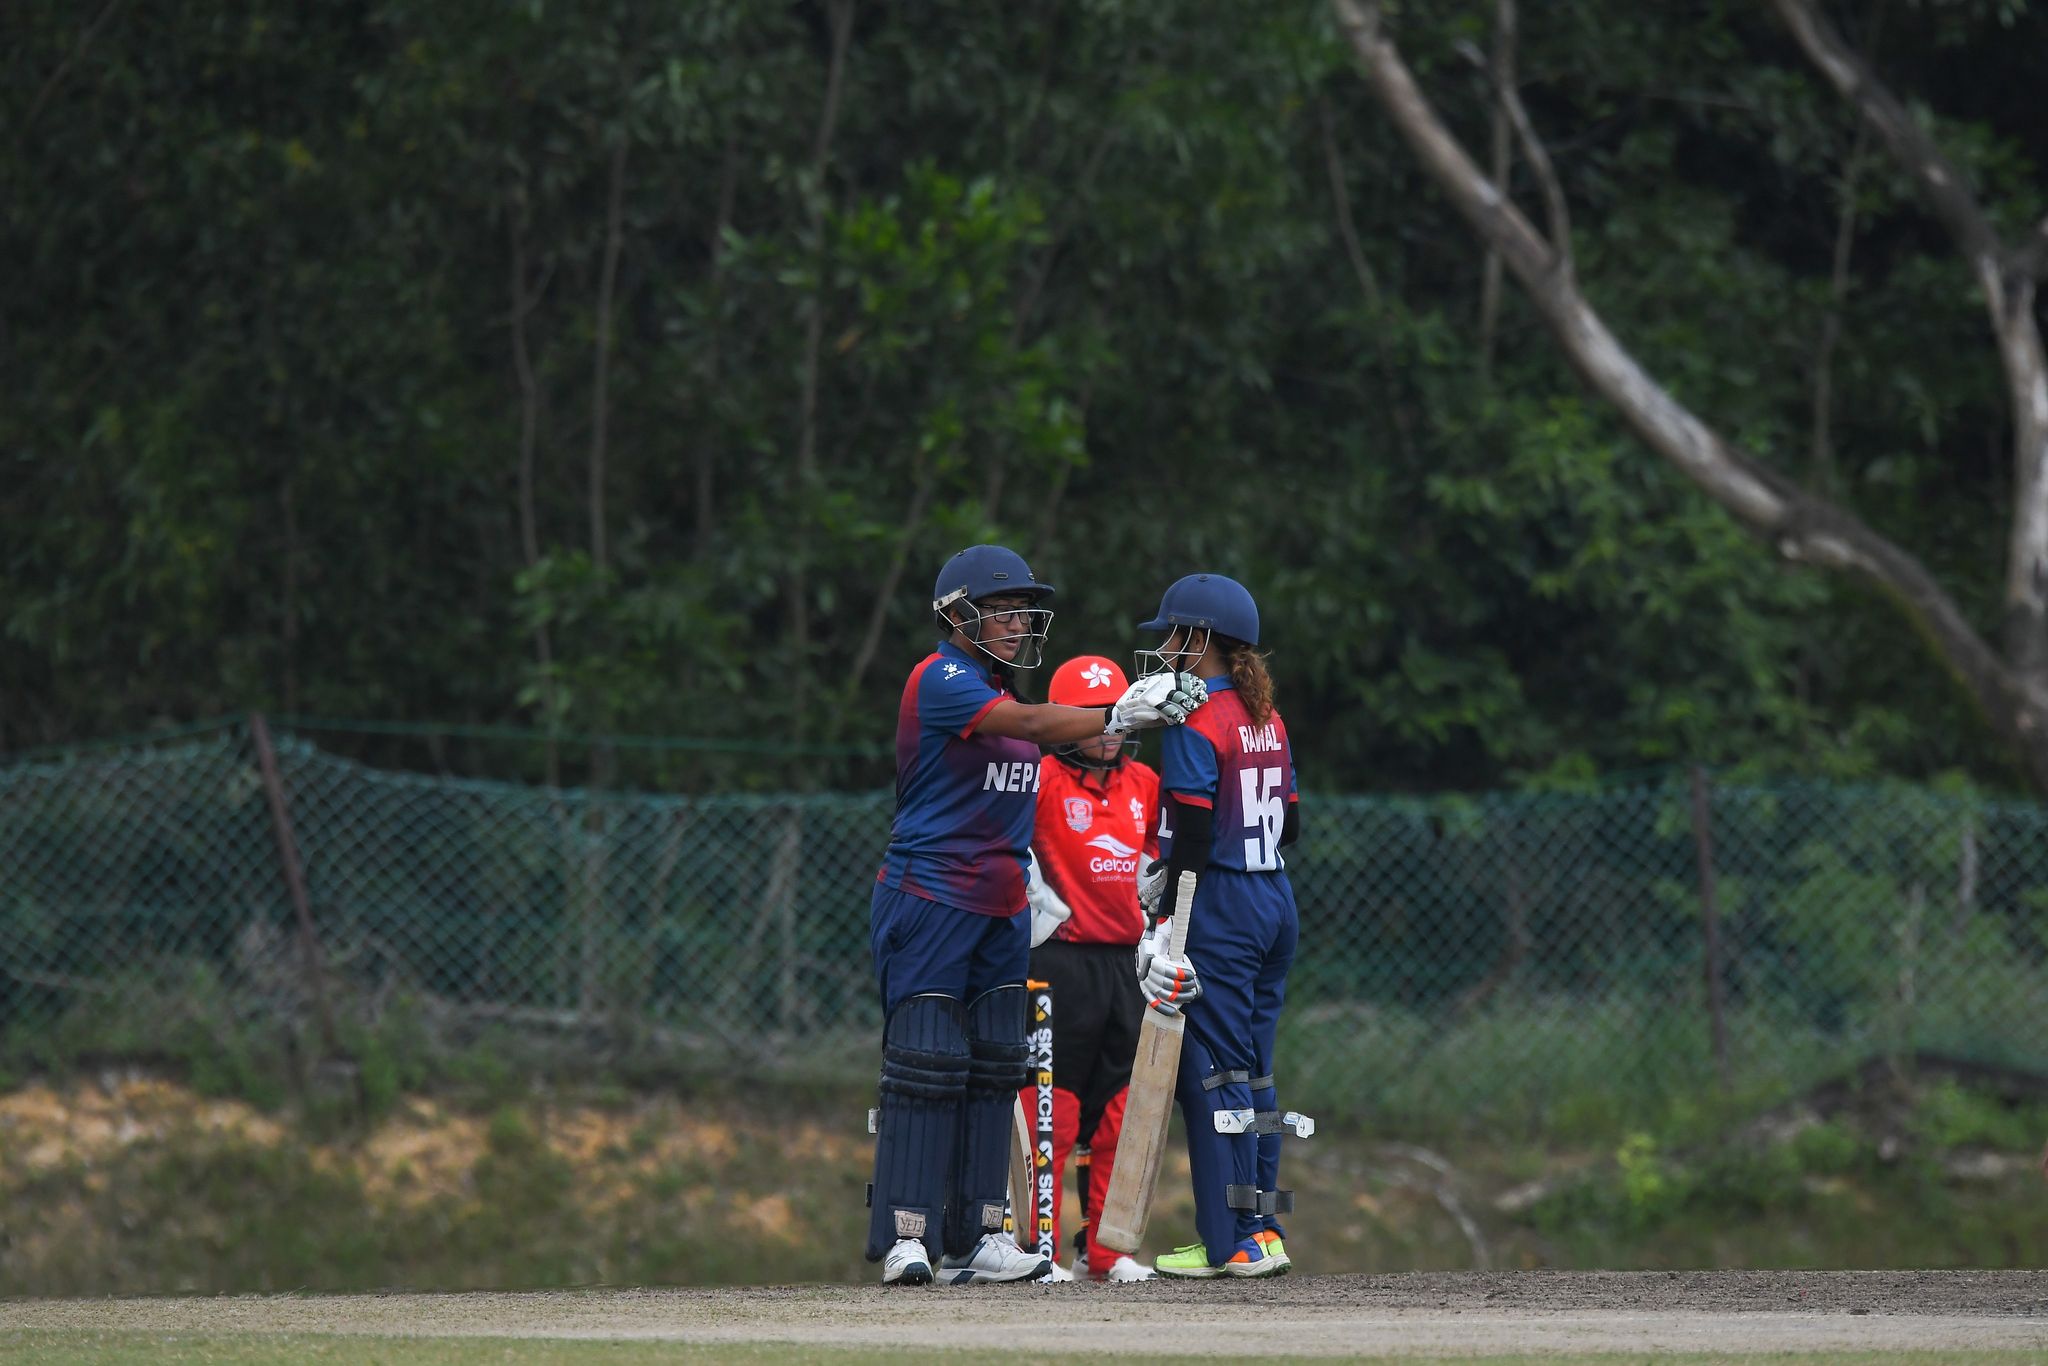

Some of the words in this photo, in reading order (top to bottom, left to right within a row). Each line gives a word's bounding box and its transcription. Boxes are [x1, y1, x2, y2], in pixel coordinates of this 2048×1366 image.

[1238, 723, 1282, 753] RAWAL
[1037, 1028, 1053, 1132] SKYEXCH
[1038, 1173, 1053, 1270] SKYEXC
